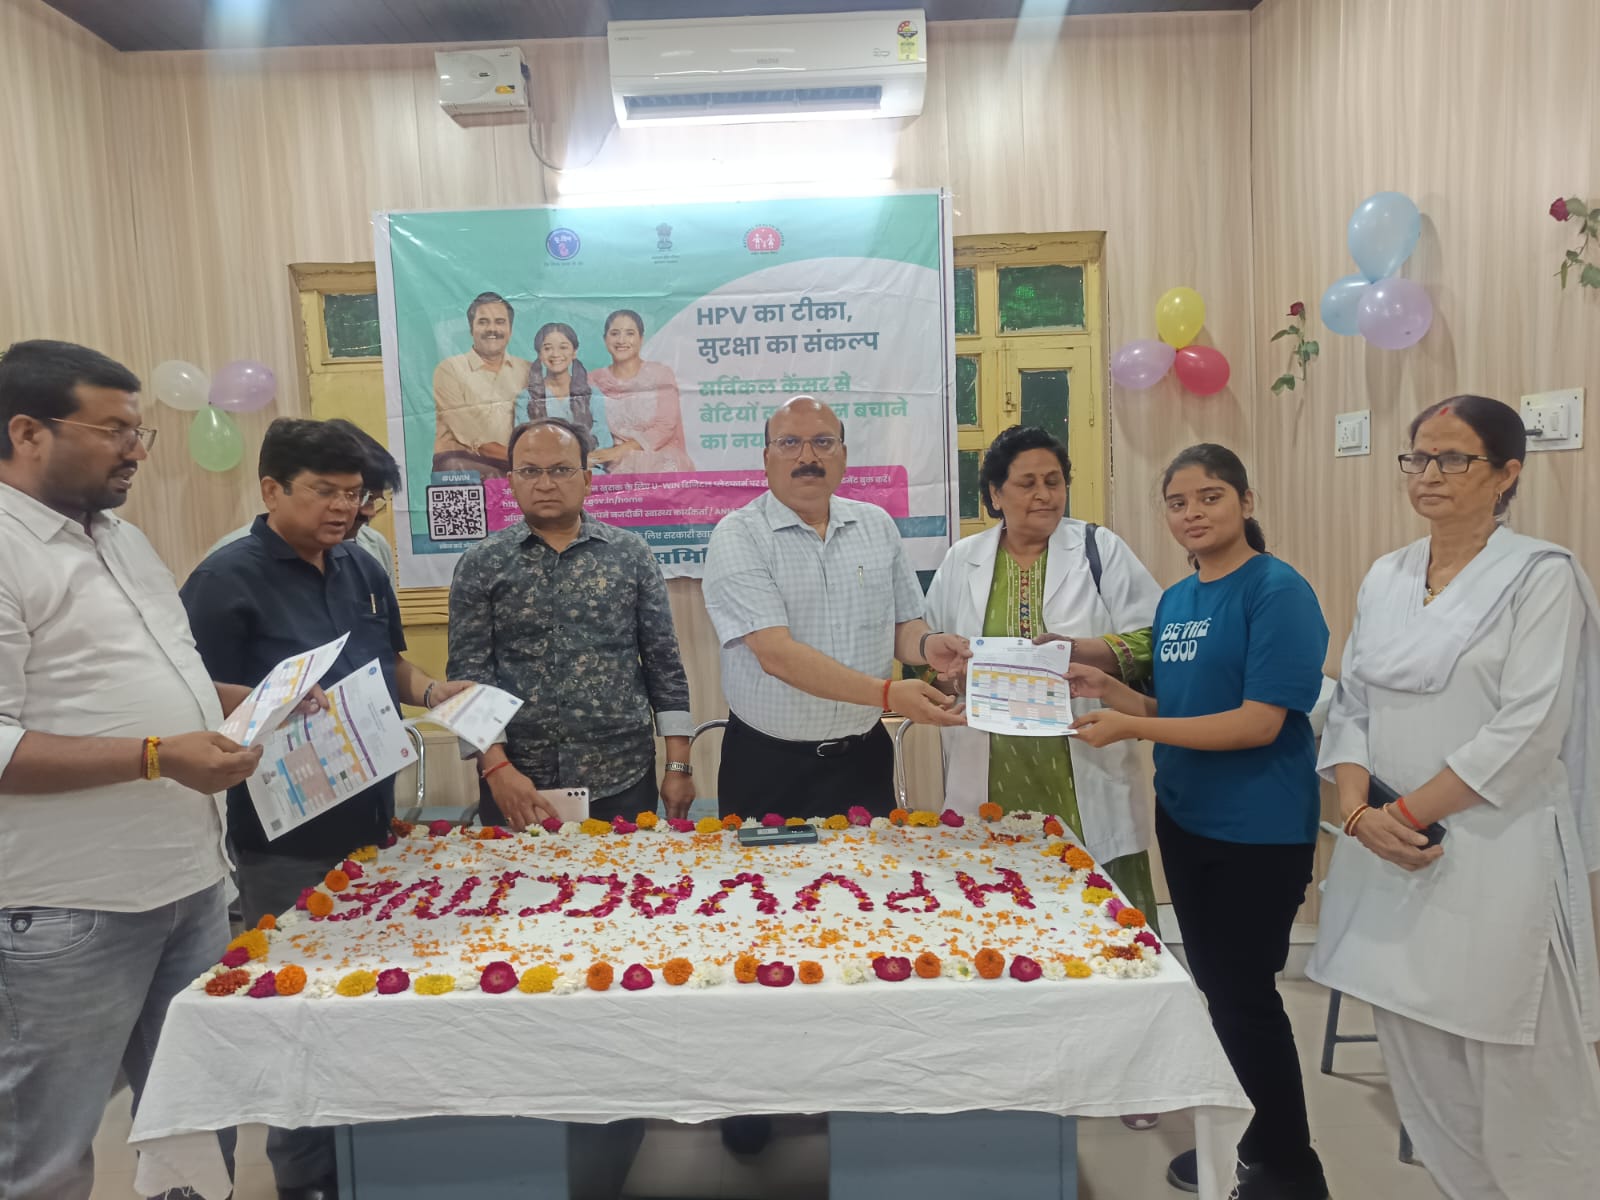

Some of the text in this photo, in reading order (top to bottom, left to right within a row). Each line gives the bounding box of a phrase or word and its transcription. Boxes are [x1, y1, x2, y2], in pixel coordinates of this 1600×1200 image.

[697, 296, 852, 326] HPV का टीका,
[697, 329, 880, 364] सुरक्षा का संकल्प
[833, 370, 852, 392] से
[699, 401, 758, 424] बेटियों
[853, 396, 908, 418] बचाने
[699, 433, 727, 450] का
[651, 481, 680, 490] U-WIN
[645, 529, 662, 540] लिए
[663, 528, 695, 540] सरकारी
[1160, 639, 1198, 662] GOOD
